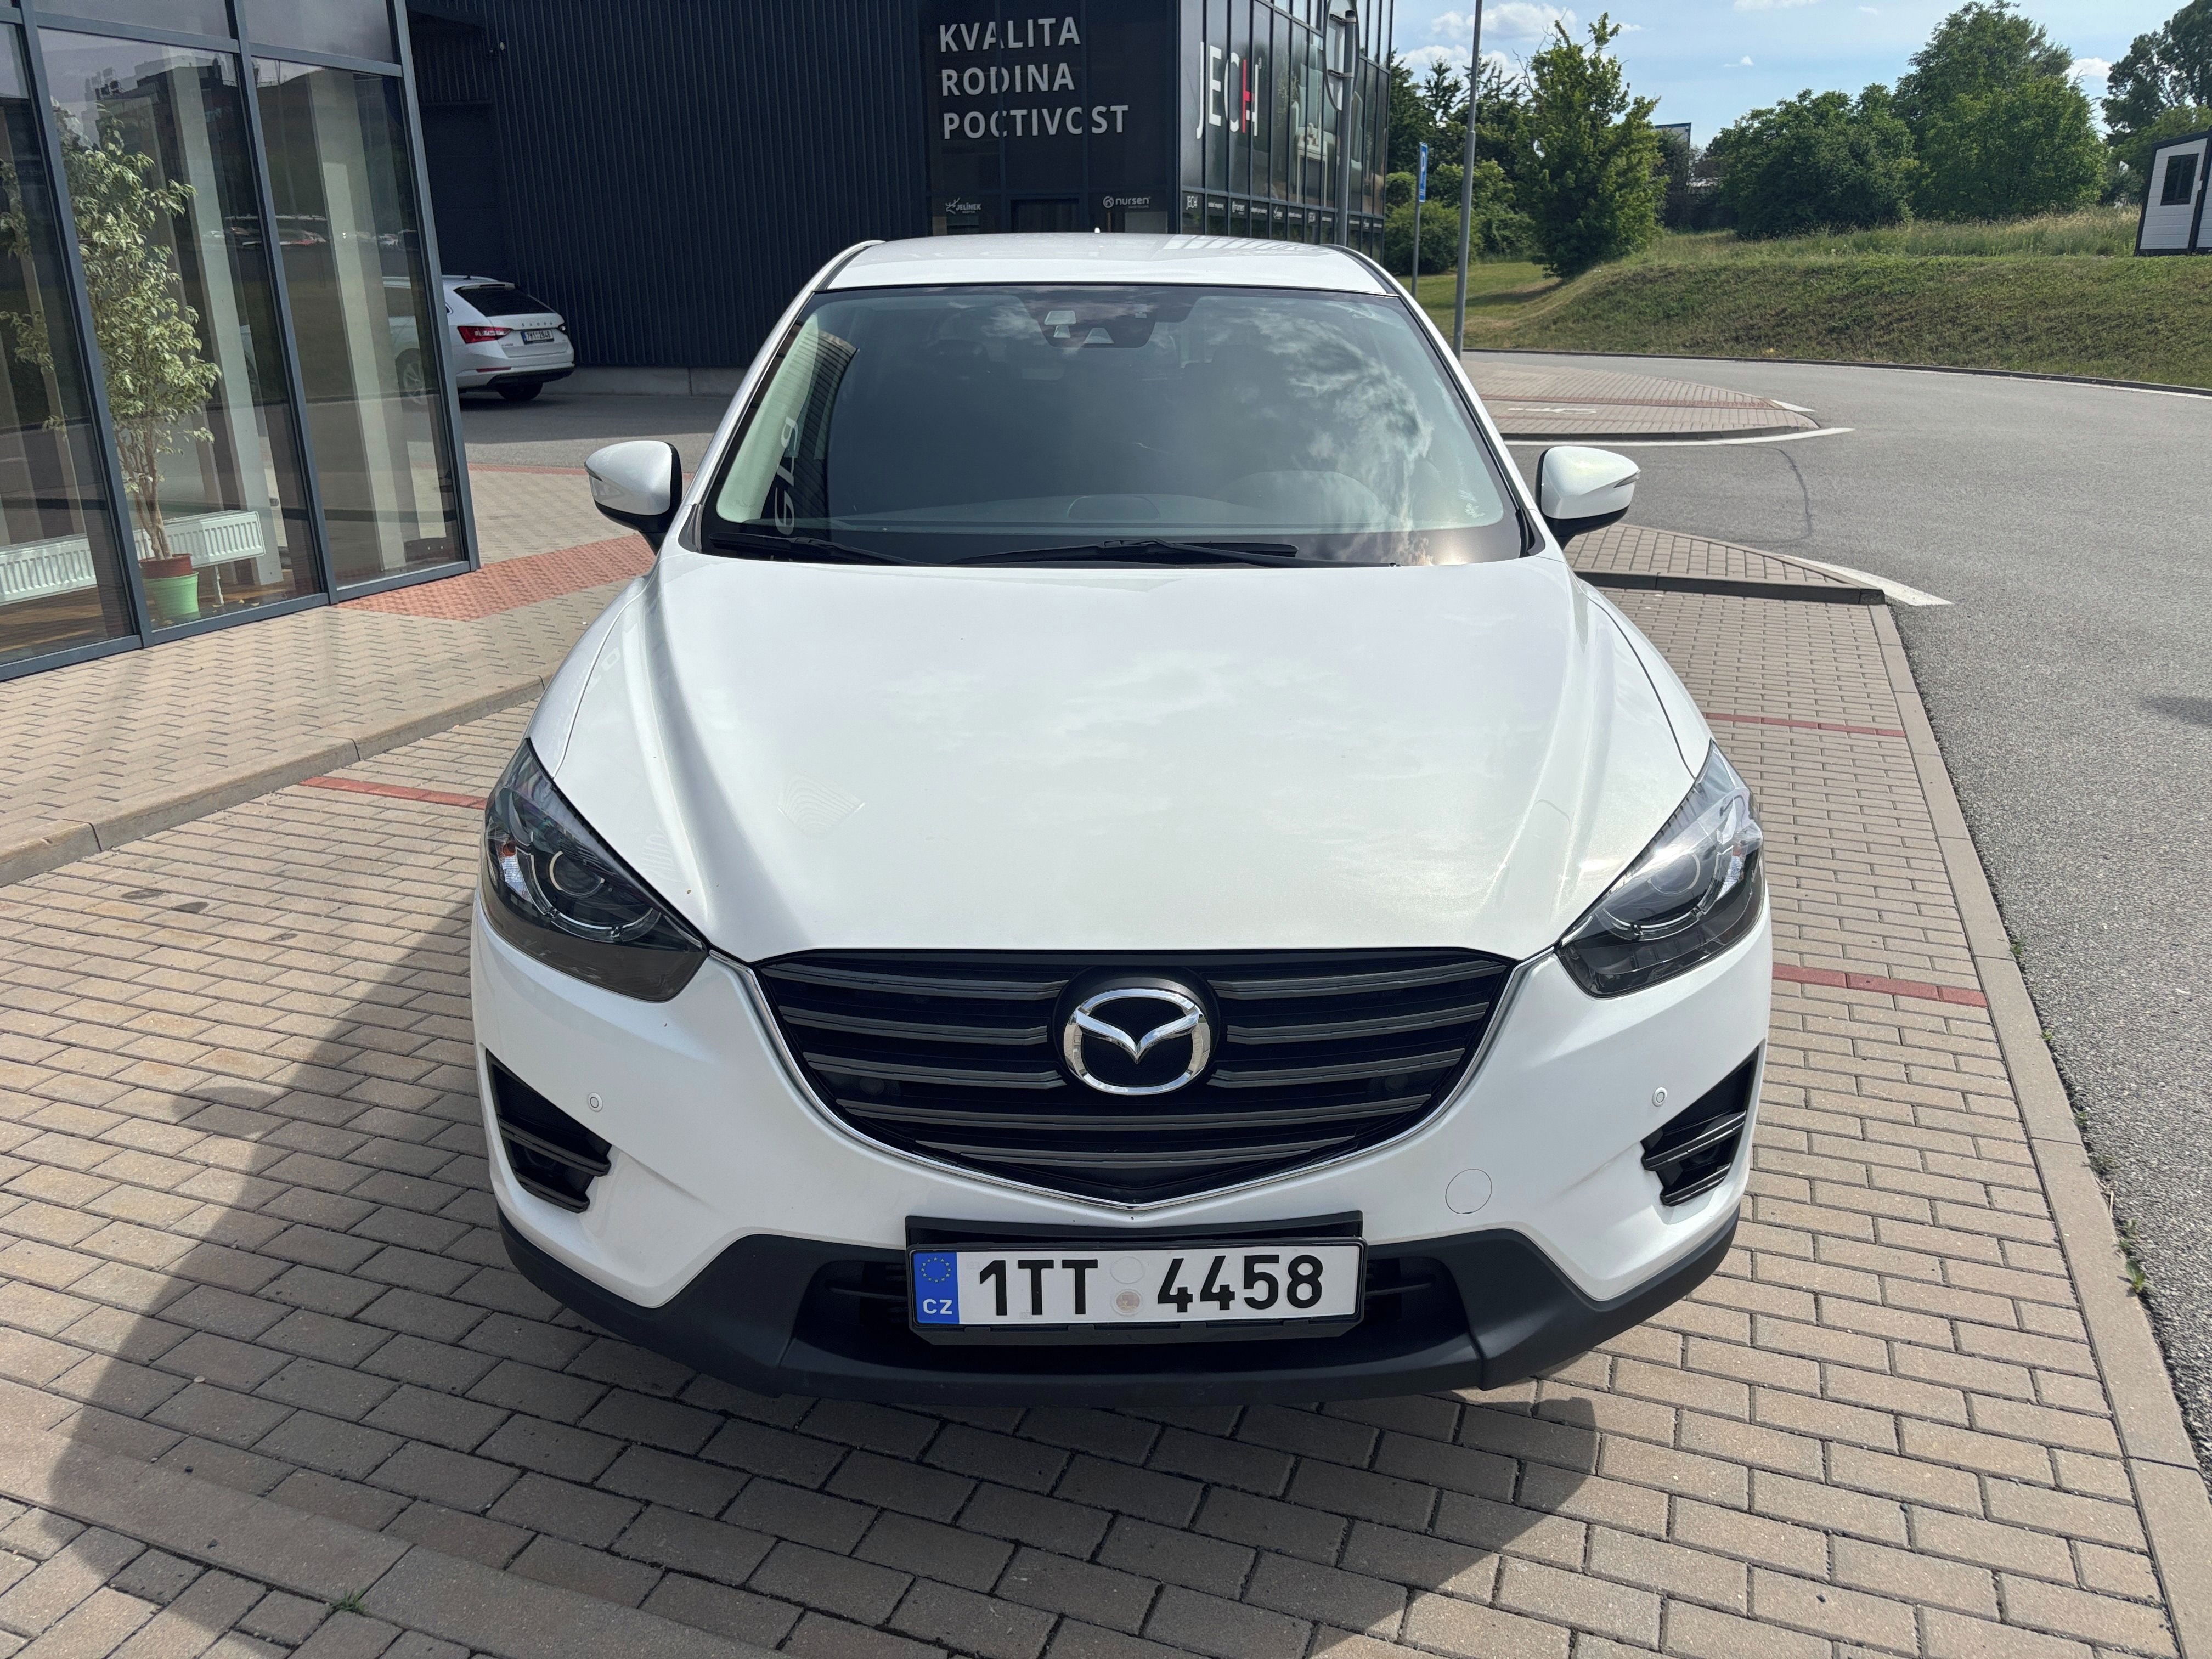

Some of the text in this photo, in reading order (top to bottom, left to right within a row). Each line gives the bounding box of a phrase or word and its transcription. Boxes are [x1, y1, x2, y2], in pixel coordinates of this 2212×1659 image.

[940, 17, 1080, 52] KVALITA
[941, 63, 1075, 96] RODINA
[979, 1254, 1323, 1316] 1TT 4458
[923, 1299, 953, 1314] CZ
